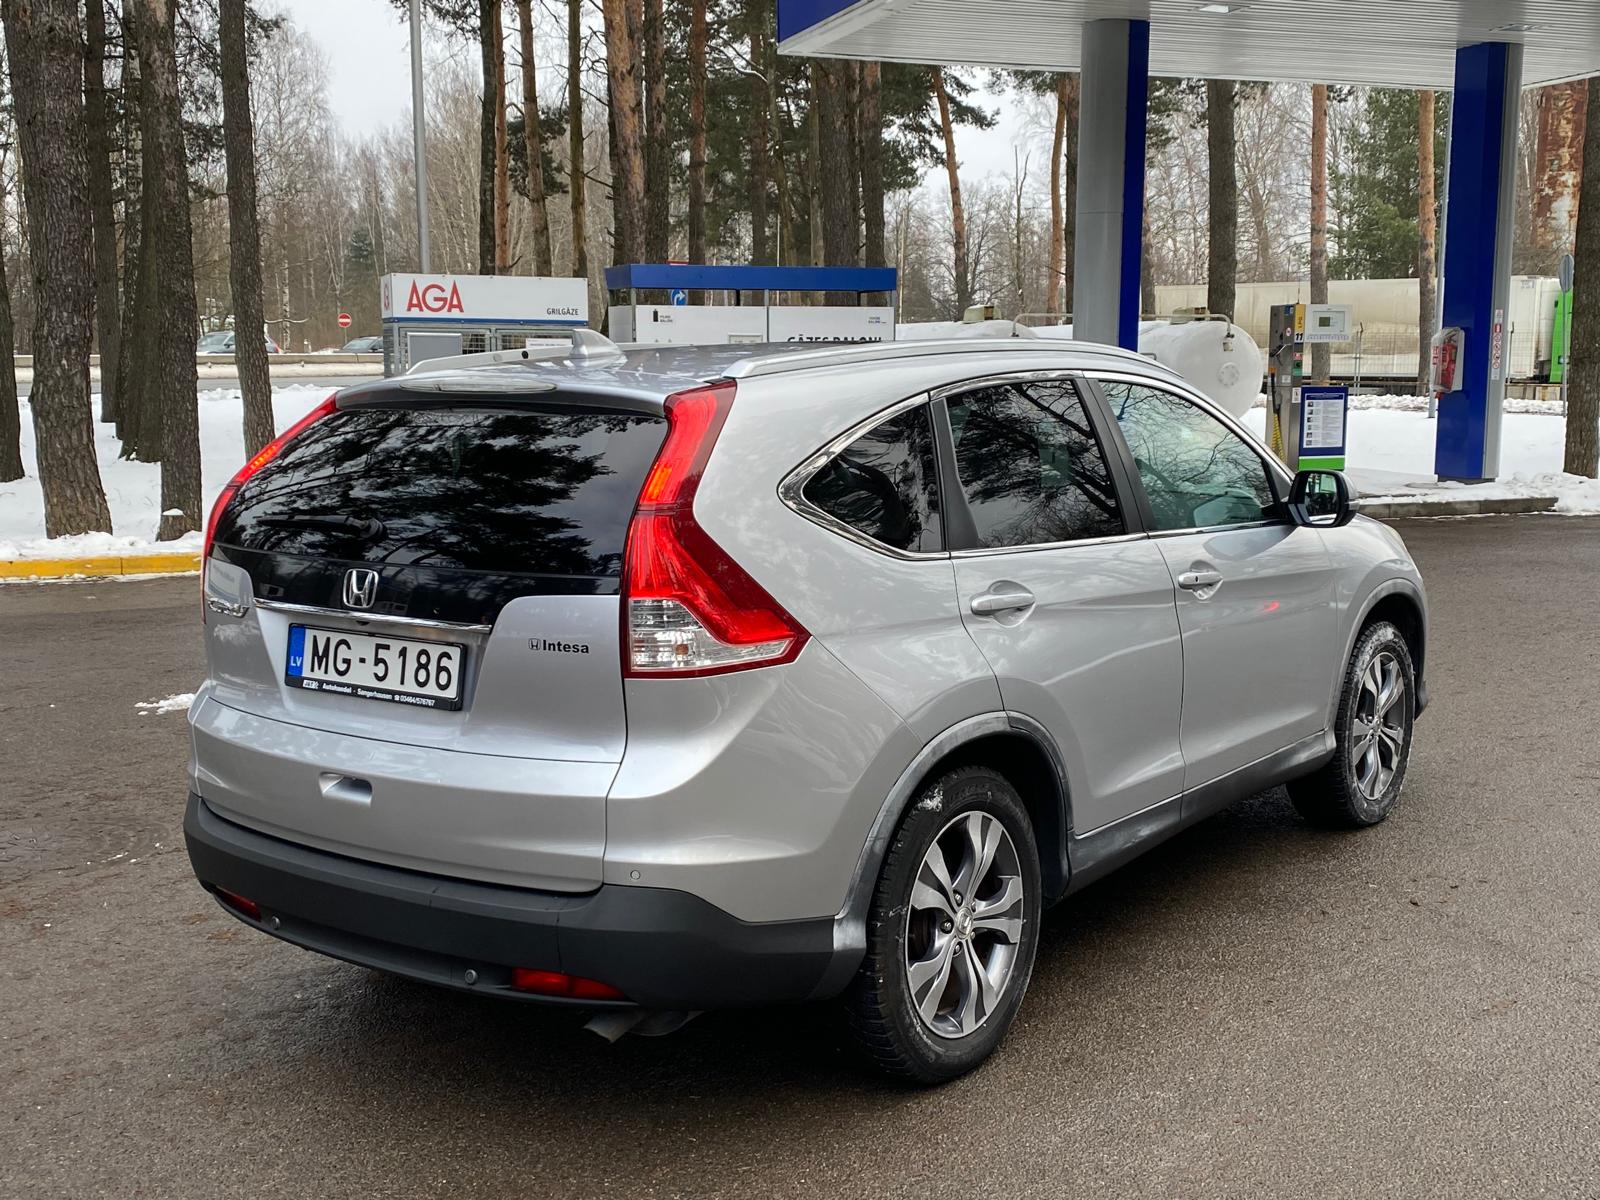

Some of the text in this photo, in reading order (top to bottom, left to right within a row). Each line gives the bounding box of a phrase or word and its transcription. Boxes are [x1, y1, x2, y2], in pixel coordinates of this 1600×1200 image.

[406, 279, 465, 313] AGA
[546, 307, 579, 316] GRILGĀZE
[1295, 332, 1304, 341] 11
[542, 639, 590, 654] Intesa
[290, 656, 302, 667] LV
[310, 634, 453, 691] MG-5186
